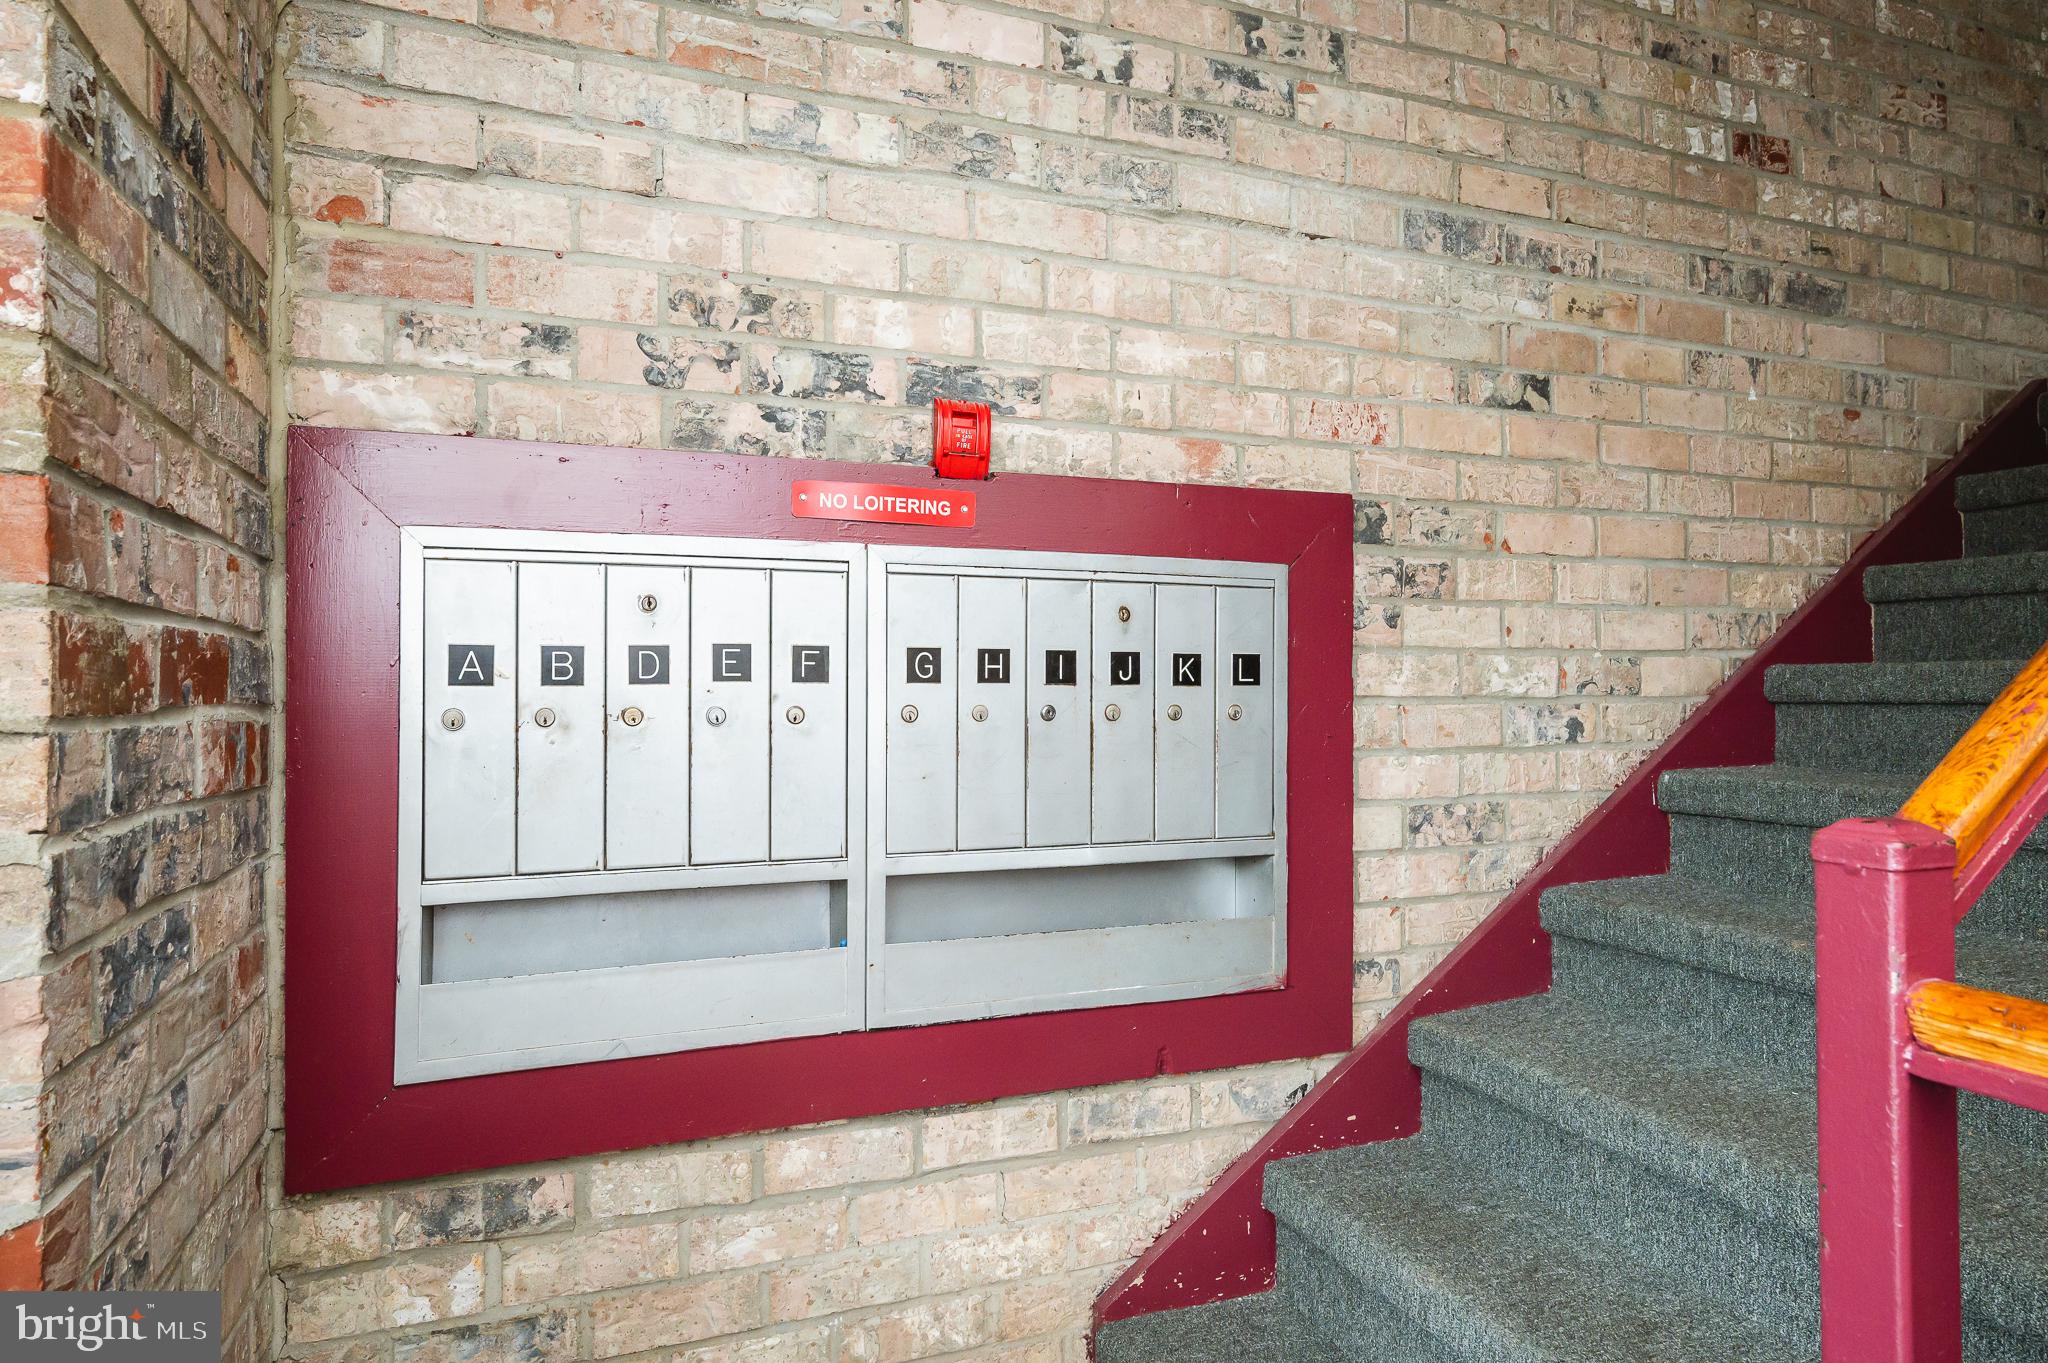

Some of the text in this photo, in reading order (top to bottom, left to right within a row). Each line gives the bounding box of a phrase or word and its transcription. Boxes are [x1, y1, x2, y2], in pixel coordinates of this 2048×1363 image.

[956, 441, 972, 449] FIRE
[819, 492, 951, 516] NO LOITERING
[458, 650, 484, 680] A
[551, 651, 574, 680] B
[638, 650, 660, 679] D
[721, 648, 742, 677] E
[801, 650, 820, 677] F
[914, 652, 934, 679] G
[984, 653, 1003, 679] H
[1119, 656, 1132, 681] J
[1179, 657, 1195, 682] K
[1238, 658, 1254, 682] L
